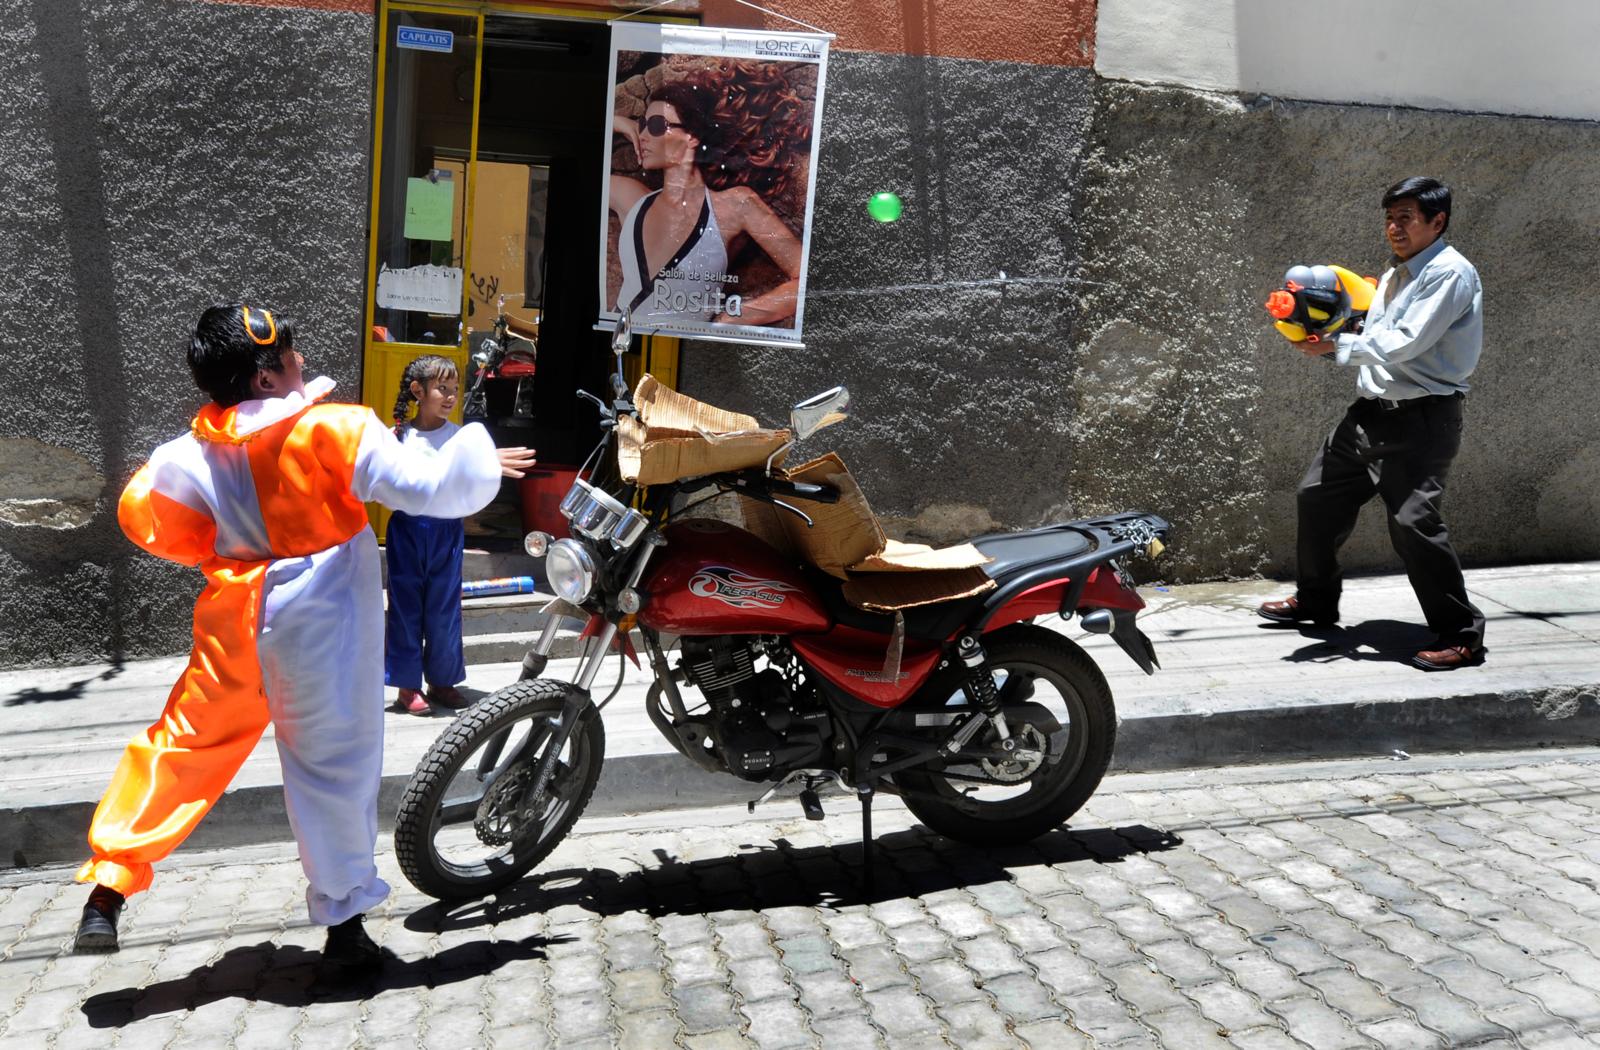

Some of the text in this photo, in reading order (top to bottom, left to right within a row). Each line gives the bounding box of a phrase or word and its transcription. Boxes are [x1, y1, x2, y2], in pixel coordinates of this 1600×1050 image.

[400, 31, 449, 44] CAPILATIS
[659, 267, 739, 284] Salón de Belleza
[653, 278, 742, 317] Rosita
[720, 584, 785, 604] PEGASUS
